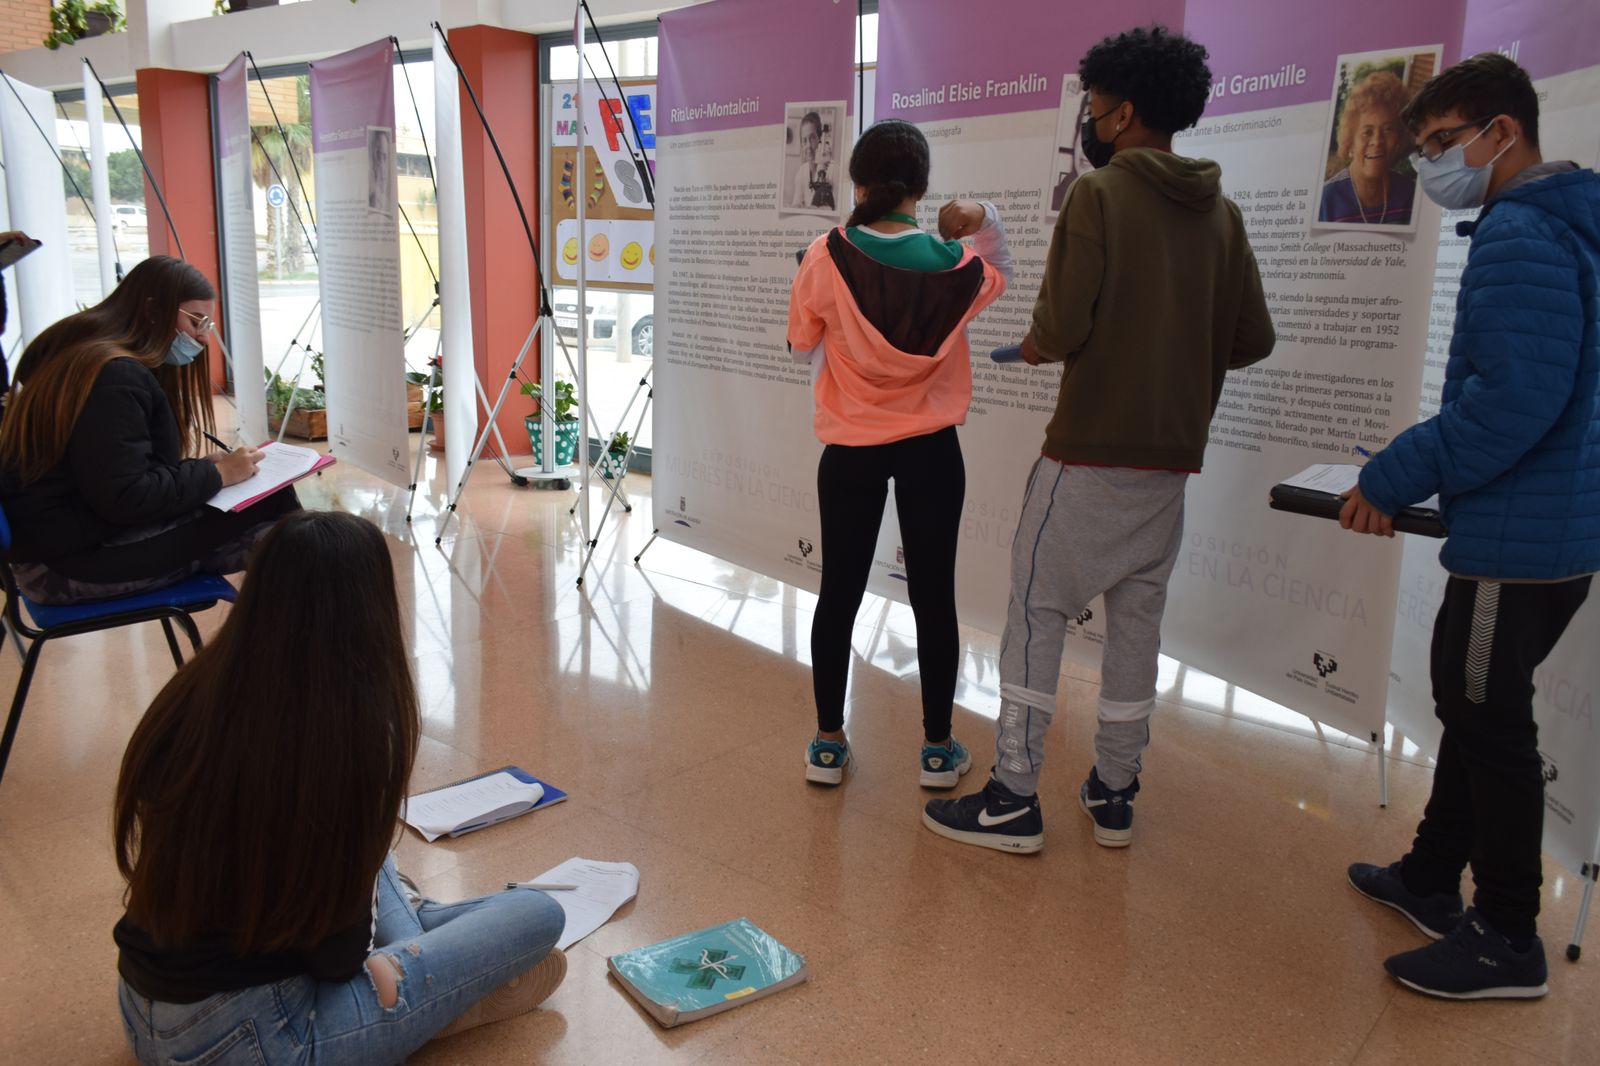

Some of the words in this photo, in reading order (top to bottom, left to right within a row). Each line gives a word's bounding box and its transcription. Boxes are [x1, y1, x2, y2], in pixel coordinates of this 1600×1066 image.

[1230, 65, 1307, 95] Granville
[892, 86, 944, 110] Rosalind
[949, 82, 981, 102] Elsie
[986, 73, 1047, 98] Franklin
[1194, 127, 1212, 137] ante
[1214, 124, 1221, 134] la
[1223, 117, 1282, 133] discriminación
[968, 191, 1003, 201] Kensington
[1004, 188, 1042, 200] (Inglaterra)
[1232, 190, 1252, 202] 1924,
[1254, 189, 1279, 200] dentro
[1281, 188, 1291, 198] de
[1293, 187, 1308, 198] una
[1008, 203, 1031, 211] obtuvo
[1034, 202, 1040, 211] el
[1254, 202, 1283, 214] después
[1286, 201, 1296, 211] de
[1298, 200, 1306, 210] la
[1031, 214, 1039, 223] de
[1250, 217, 1273, 228] Evelyn
[1274, 216, 1298, 228] quedó
[1017, 227, 1023, 235] al
[1270, 230, 1299, 243] mujeres
[1018, 239, 1025, 247] el
[1025, 239, 1048, 248] grafito.
[1279, 242, 1301, 252] Smith
[1302, 242, 1331, 254] College
[1332, 241, 1408, 254] (Massachusetts).
[1270, 256, 1299, 269] ingresó
[1299, 258, 1309, 267] en
[1310, 257, 1318, 267] la
[1319, 256, 1369, 267] Universidad
[1370, 257, 1382, 267] de
[1384, 257, 1407, 268] Yale,
[1022, 271, 1029, 279] le
[1266, 269, 1292, 280] teórica
[1299, 270, 1347, 281] astronomía.
[1279, 293, 1304, 304] siendo
[1305, 293, 1313, 304] la
[1314, 295, 1349, 307] segunda
[1351, 296, 1378, 308] mujer
[1380, 296, 1402, 306] afro-
[989, 305, 1013, 314] trabajos
[1293, 308, 1350, 319] universidades
[1351, 312, 1359, 320] y
[1361, 310, 1401, 322] soportar
[987, 317, 1026, 326] discriminada
[1277, 320, 1312, 331] comenzó
[1322, 323, 1357, 335] trabajar
[1360, 326, 1372, 335] en
[1376, 325, 1400, 336] 1952
[1299, 333, 1337, 347] aprendió
[1339, 336, 1348, 346] la
[1350, 340, 1398, 351] programa-
[976, 362, 992, 370] junto
[999, 363, 1022, 373] Wilkins
[1023, 366, 1030, 374] el
[1031, 368, 1055, 377] premio
[973, 372, 982, 380] del
[1001, 375, 1027, 386] Rosalind
[1029, 379, 1039, 387] no
[1040, 378, 1060, 390] figuró
[1246, 366, 1263, 378] gran
[1265, 367, 1291, 380] equipo
[1292, 369, 1303, 379] de
[1304, 371, 1365, 385] investigadores
[1367, 377, 1378, 387] en
[1381, 377, 1394, 389] los
[986, 386, 994, 394] de
[996, 388, 1018, 396] ovarios
[1020, 391, 1029, 399] en
[1032, 391, 1049, 401] 1958
[1242, 376, 1249, 387] el
[1250, 378, 1269, 388] envío
[1271, 380, 1281, 390] de
[1282, 381, 1294, 391] las
[1295, 383, 1332, 397] primeras
[1334, 387, 1375, 401] personas
[1384, 392, 1392, 403] la
[1016, 400, 1025, 410] los
[1224, 388, 1252, 399] trabajos
[1253, 391, 1289, 405] similares,
[1298, 396, 1331, 411] después
[1333, 401, 1372, 415] continuó
[1374, 407, 1390, 418] con
[1248, 403, 1281, 418] Participó
[1284, 409, 1333, 424] activamente
[1336, 416, 1348, 426] en
[1351, 416, 1360, 427] el
[1364, 418, 1390, 431] Movi-
[1218, 413, 1274, 429] afroamericanos,
[1275, 420, 1308, 434] liderado
[1310, 426, 1324, 437] por
[1327, 427, 1356, 441] Martín
[1359, 431, 1388, 445] Luther
[1220, 427, 1229, 435] un
[1230, 427, 1267, 441] doctorado
[1268, 433, 1309, 448] honorífico,
[1311, 440, 1340, 453] siendo
[1341, 443, 1349, 453] la
[1224, 439, 1262, 453] americana.
[665, 453, 722, 487] MUJERES
[725, 469, 745, 495] EN
[747, 475, 765, 500] LA
[963, 518, 989, 544] EN
[1188, 551, 1218, 582] EN
[1226, 563, 1255, 593] LA
[1263, 572, 1369, 627] CIENCIA
